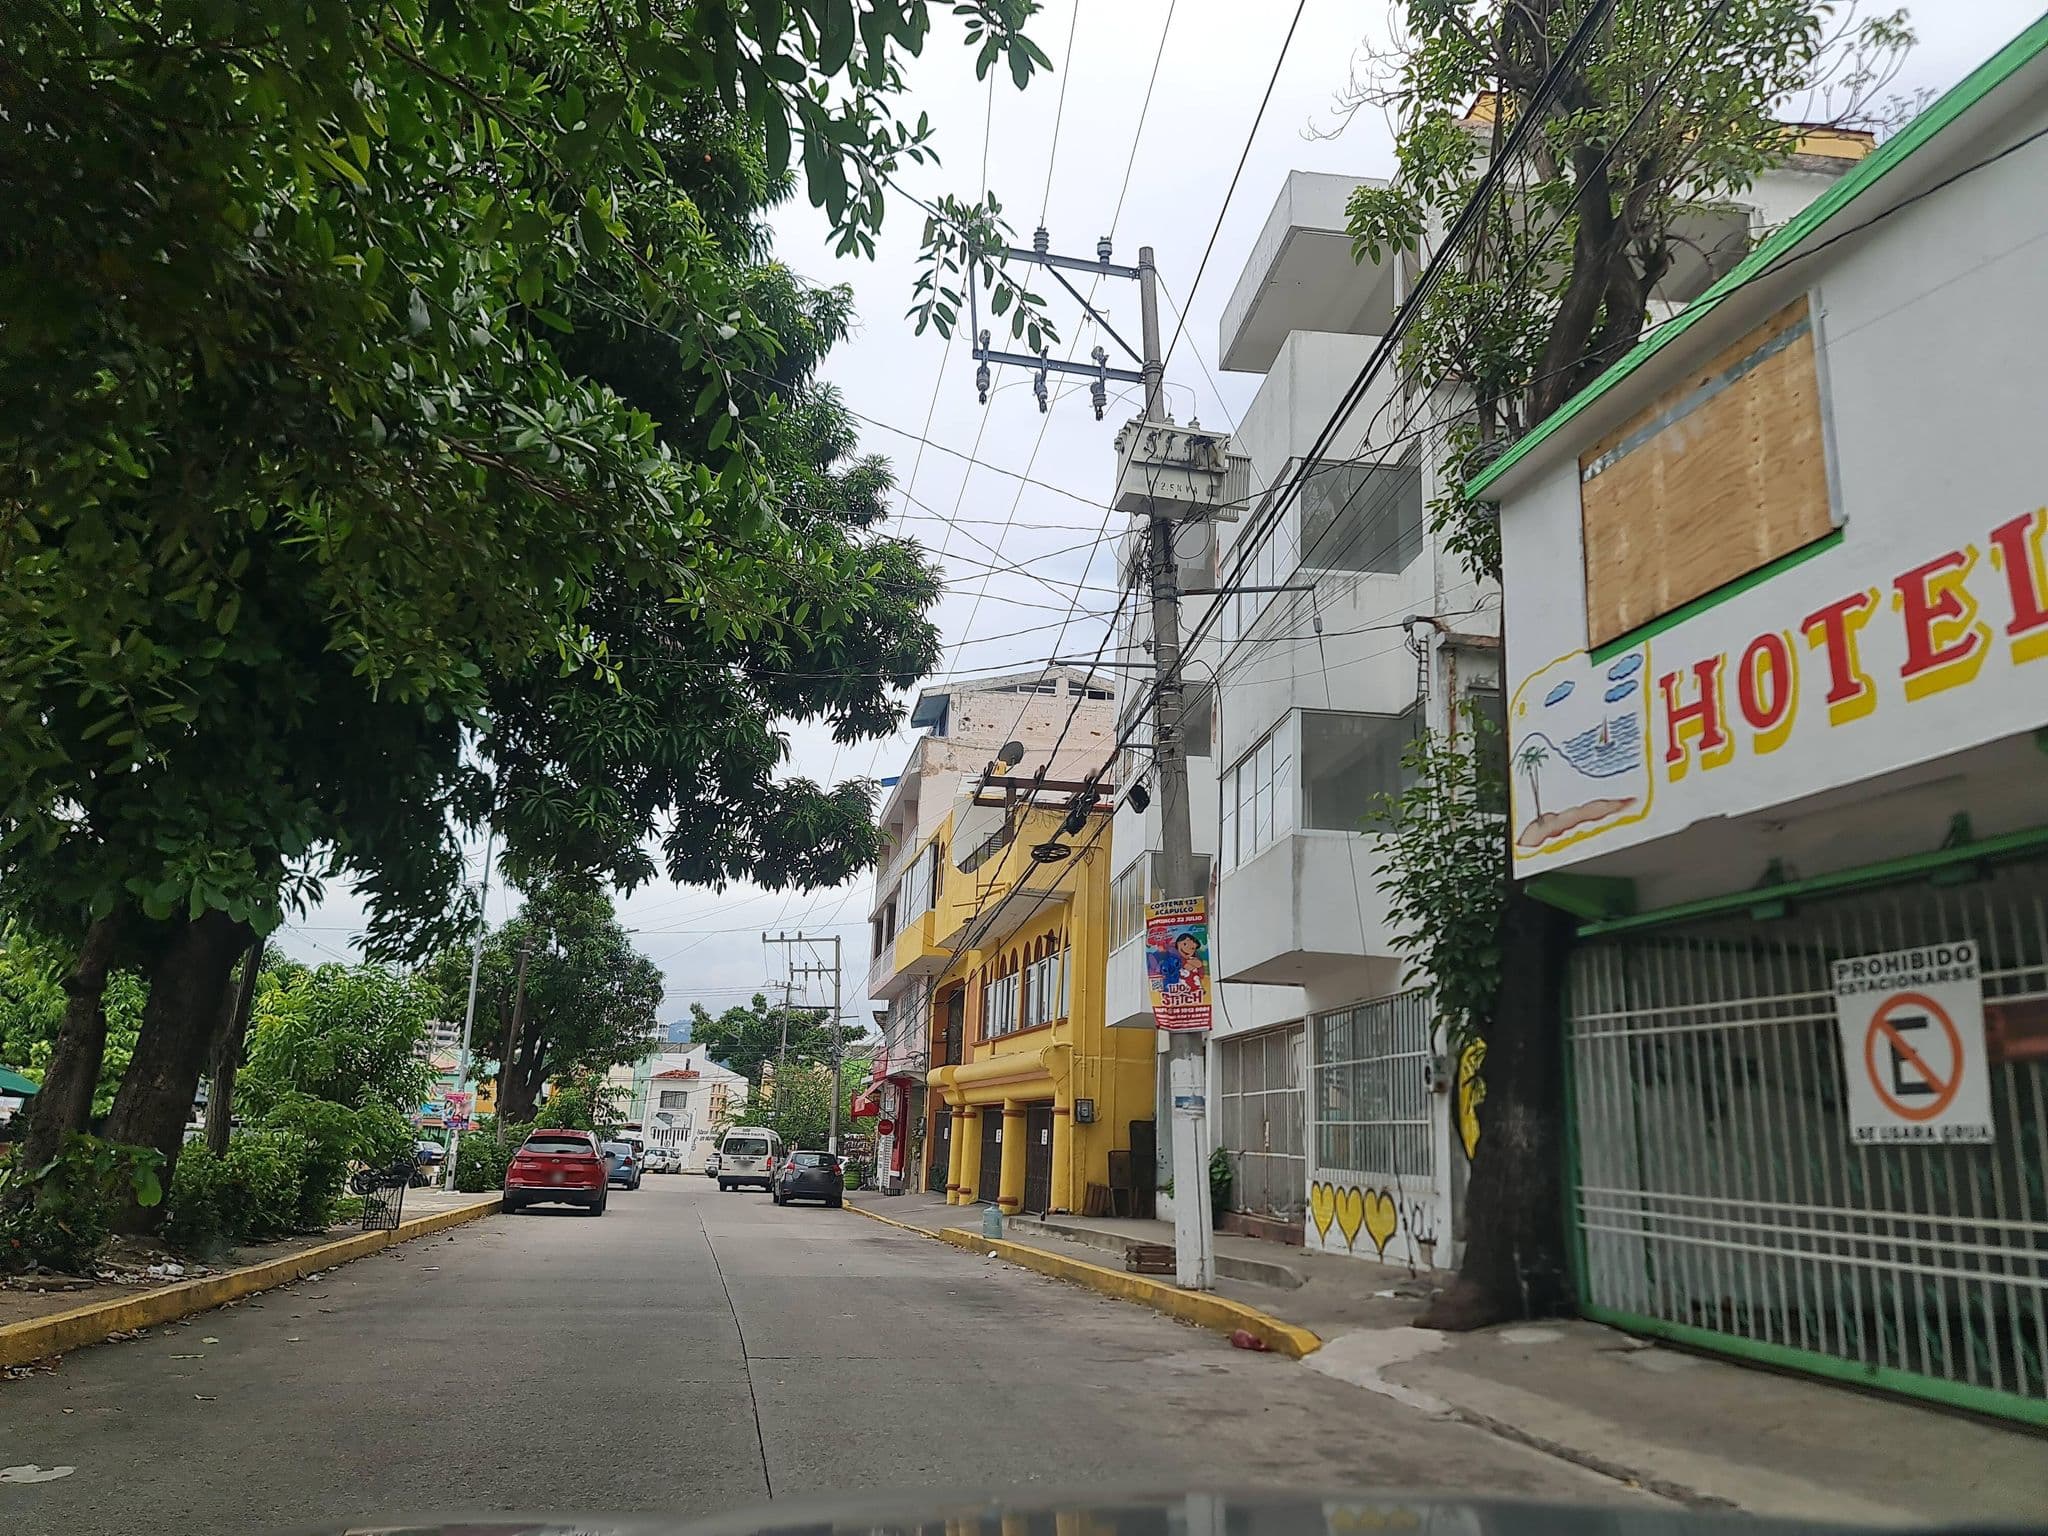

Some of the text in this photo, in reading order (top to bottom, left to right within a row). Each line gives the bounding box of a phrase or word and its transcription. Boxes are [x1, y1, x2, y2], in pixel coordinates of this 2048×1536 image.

[1658, 507, 2048, 781] HOTEL
[1151, 900, 1183, 910] COSTERA
[1155, 906, 1194, 915] ACAPULCO
[1838, 946, 1972, 979] PROHIBIDO
[1838, 965, 1975, 995] ESTACIONARSE
